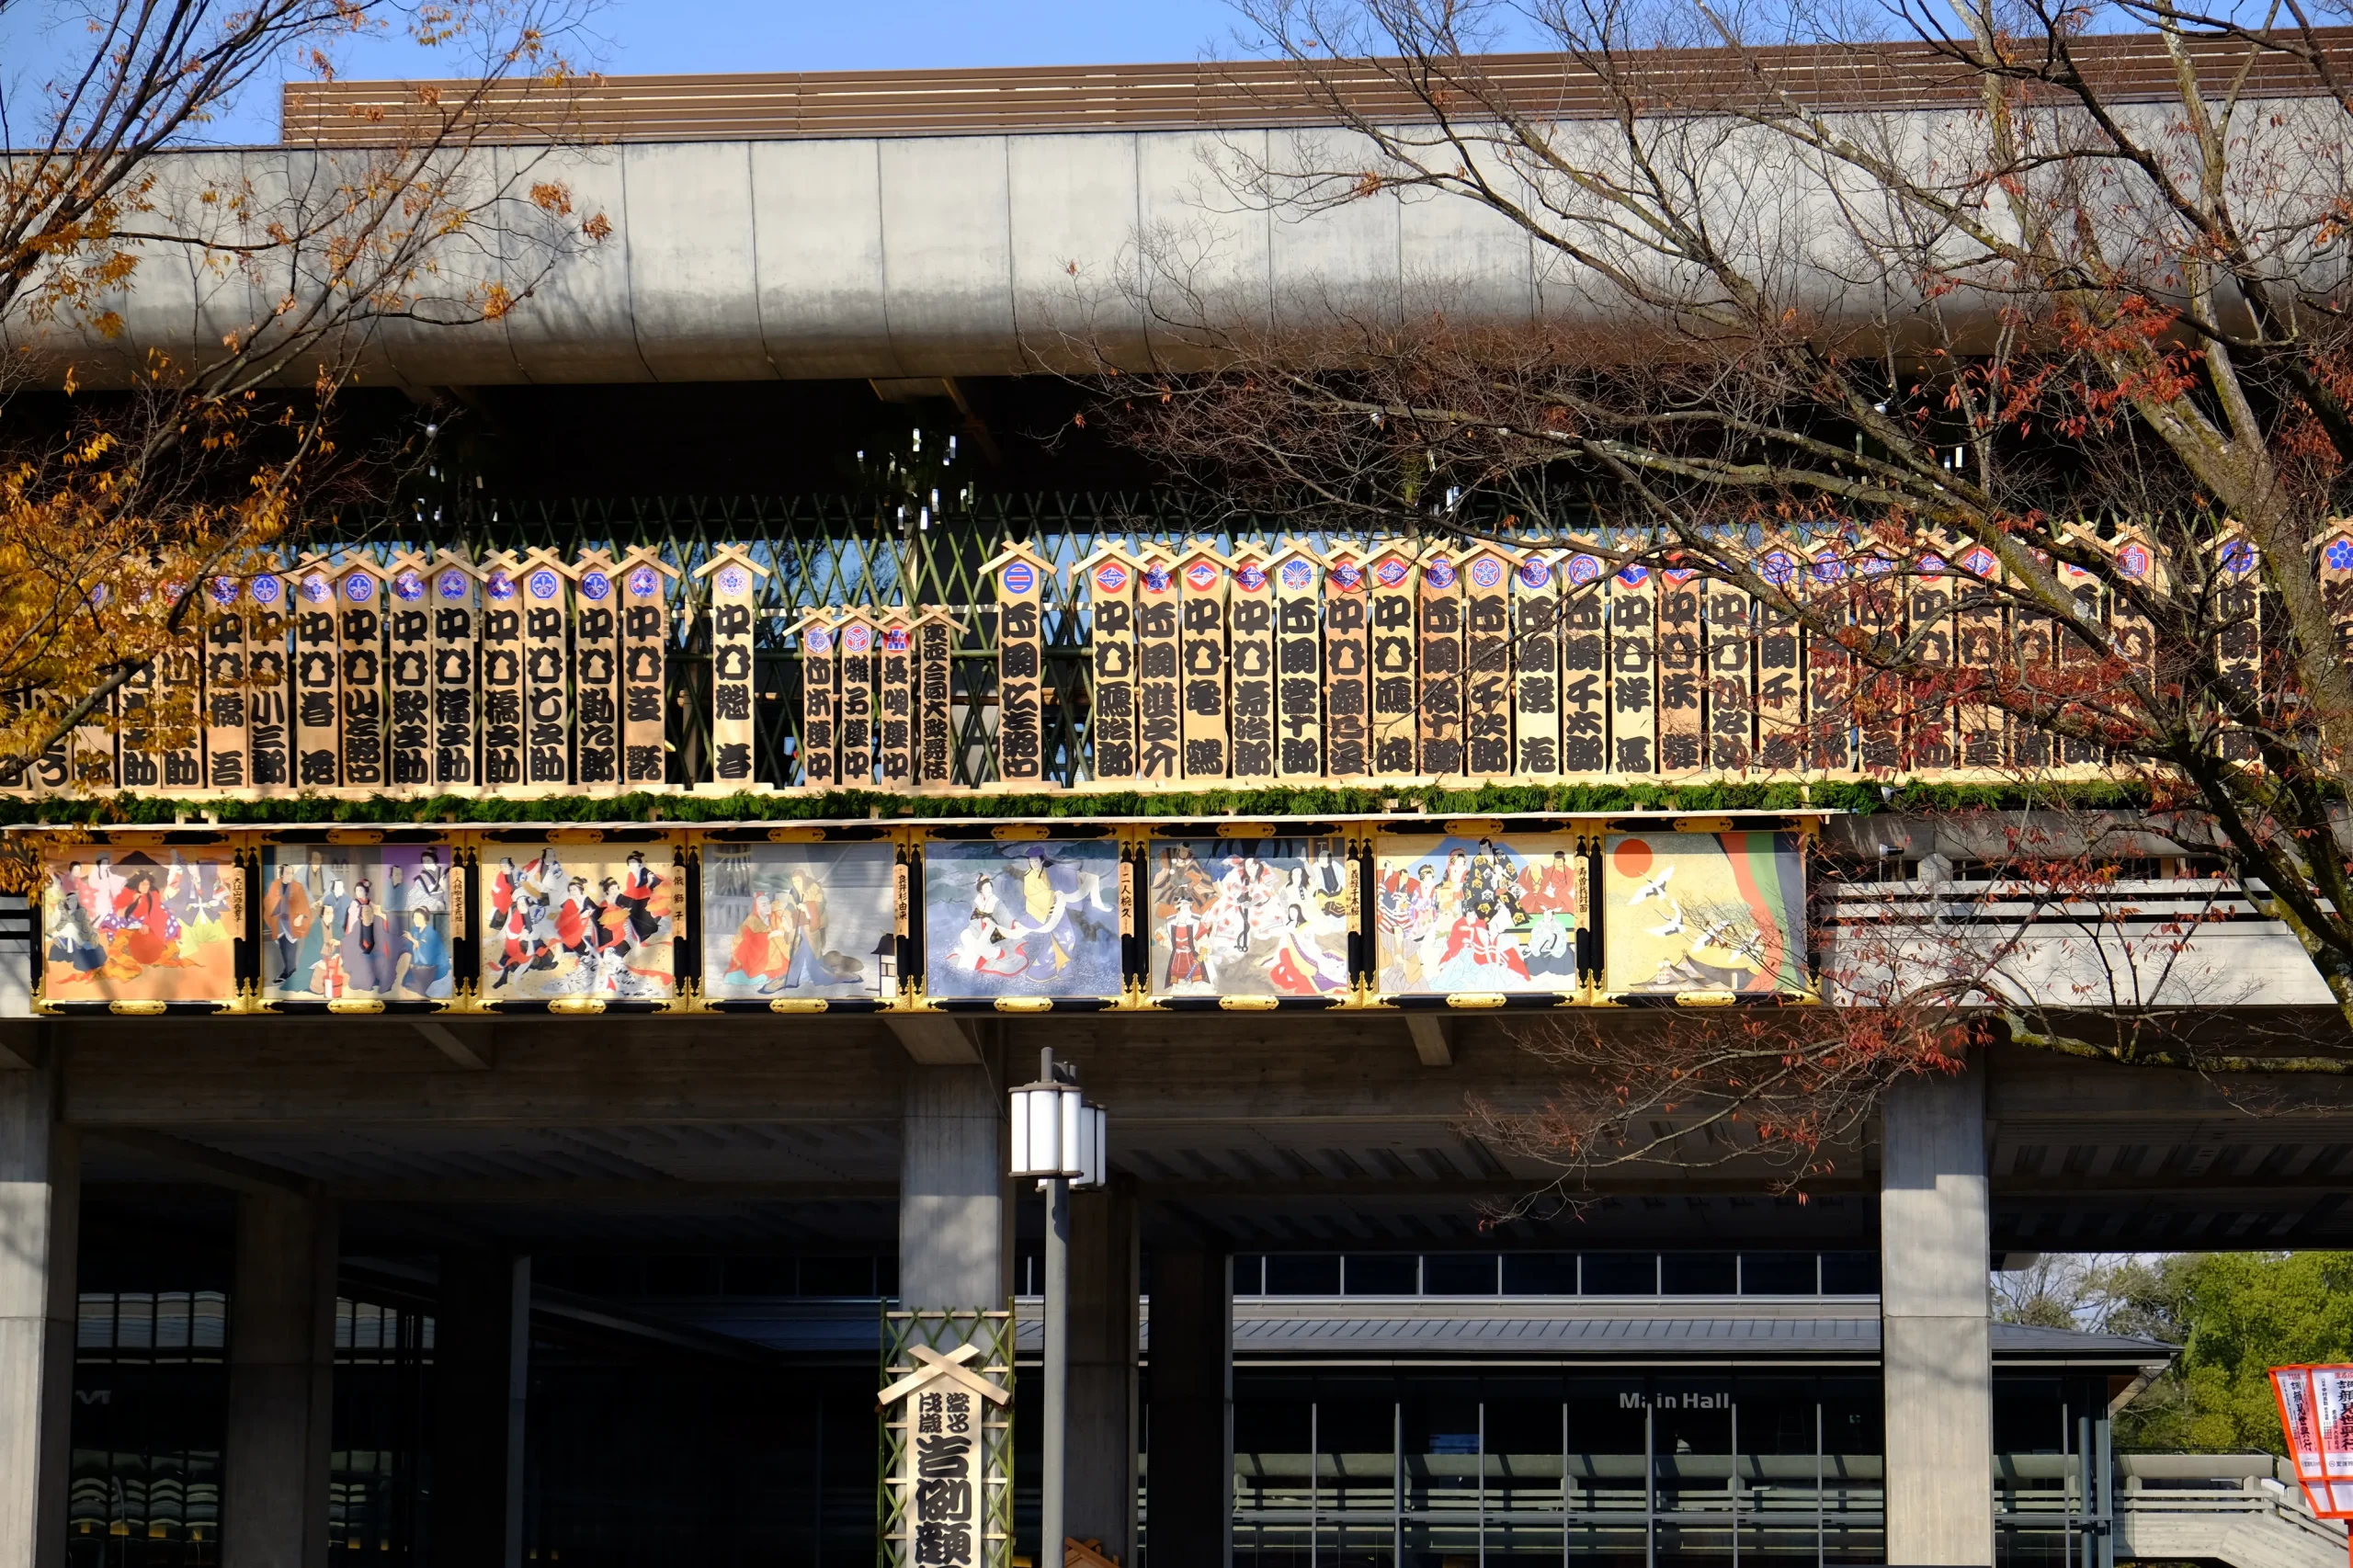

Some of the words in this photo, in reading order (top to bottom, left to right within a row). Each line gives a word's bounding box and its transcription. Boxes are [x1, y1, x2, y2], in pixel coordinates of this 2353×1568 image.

[392, 609, 428, 783] 中村歌之助
[435, 608, 471, 782] 中村福之助
[484, 609, 519, 783] 中村橋之助
[527, 607, 564, 781] 中村七之助
[578, 608, 615, 782] 中村勘九郎
[626, 605, 662, 780] 中村芝翫
[715, 603, 752, 778] 中村魁春
[844, 654, 870, 778] 囃子連中
[883, 655, 908, 780] 長唄連中
[923, 623, 949, 780] 東西合同大歌舞伎
[1000, 601, 1039, 778] 片岡仁左衛門
[1139, 601, 1178, 778] 片岡進之介
[1683, 1392, 1729, 1408] Hall
[915, 1435, 972, 1568] 吉例顔
